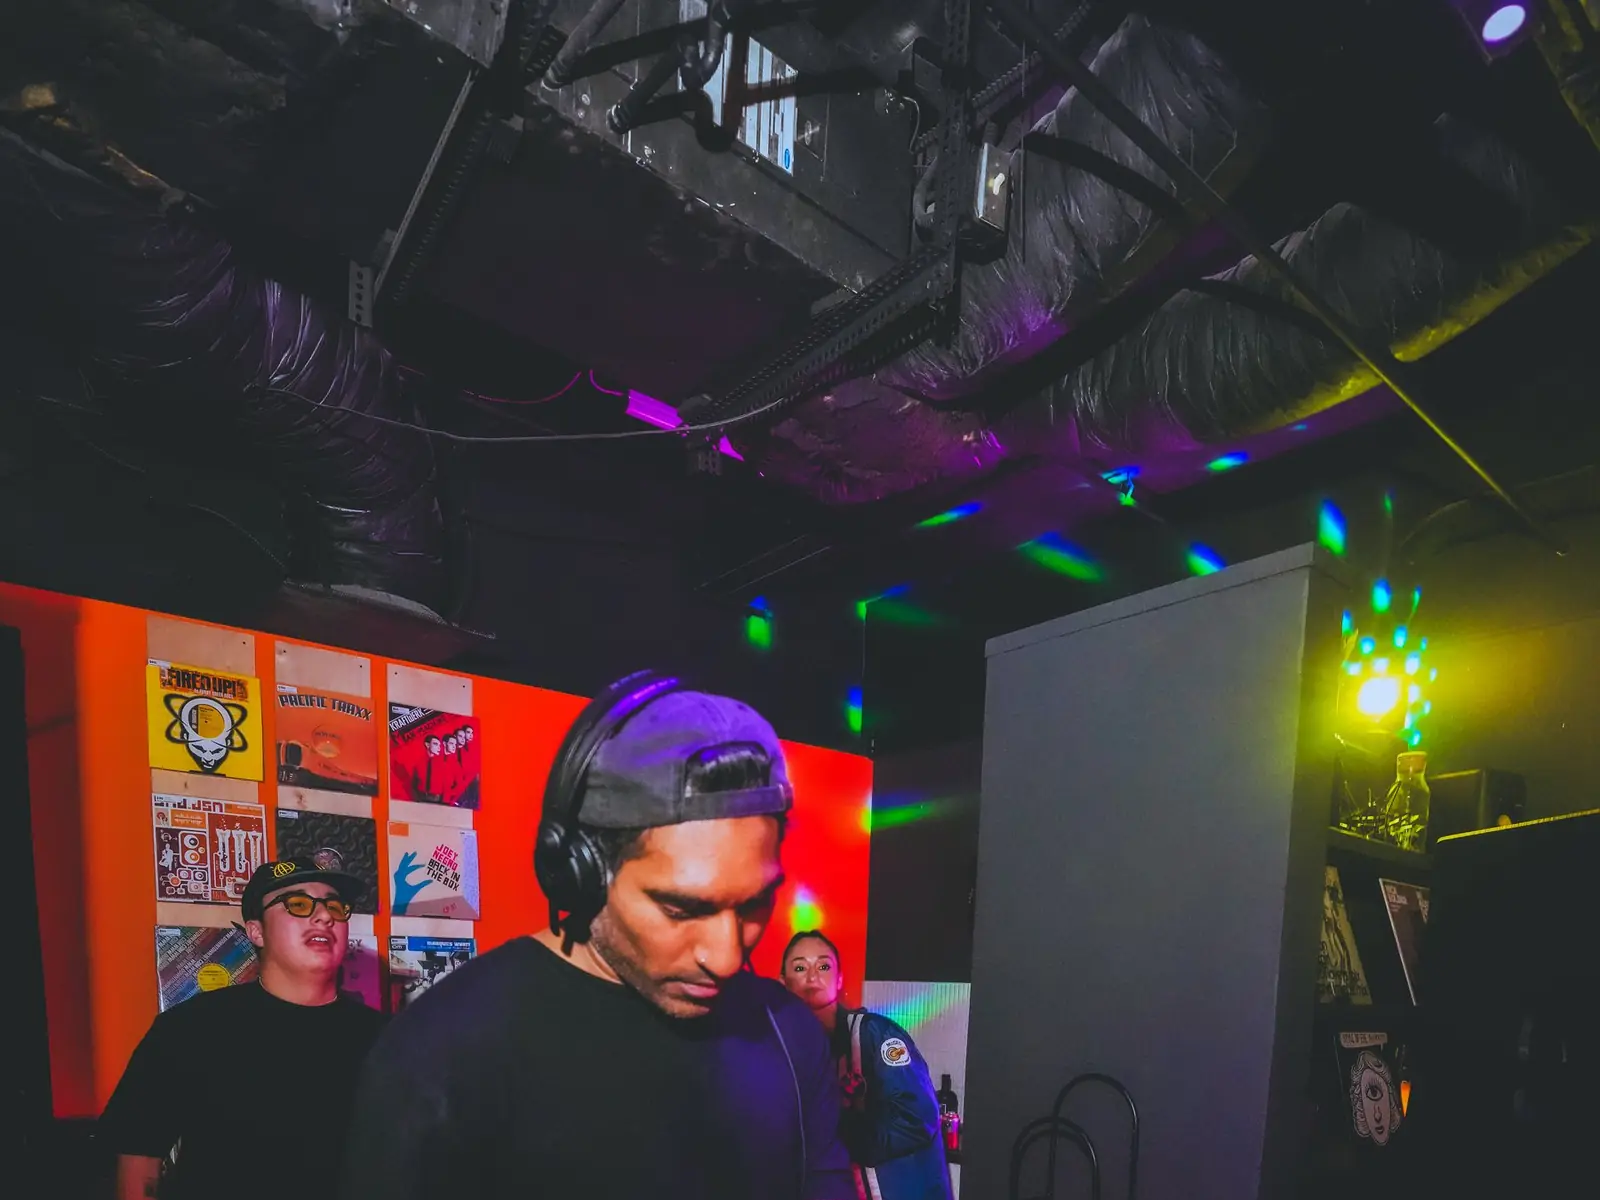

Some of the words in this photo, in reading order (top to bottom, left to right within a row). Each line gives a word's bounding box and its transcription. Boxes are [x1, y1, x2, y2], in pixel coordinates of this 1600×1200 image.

[278, 694, 328, 710] PACIFIC
[389, 707, 426, 732] KRAFTWERK
[432, 850, 459, 872] NEGRO
[436, 844, 459, 860] JOEY
[426, 867, 443, 882] THE
[442, 879, 460, 892] BOX
[428, 858, 450, 875] BACK
[451, 871, 461, 883] IN
